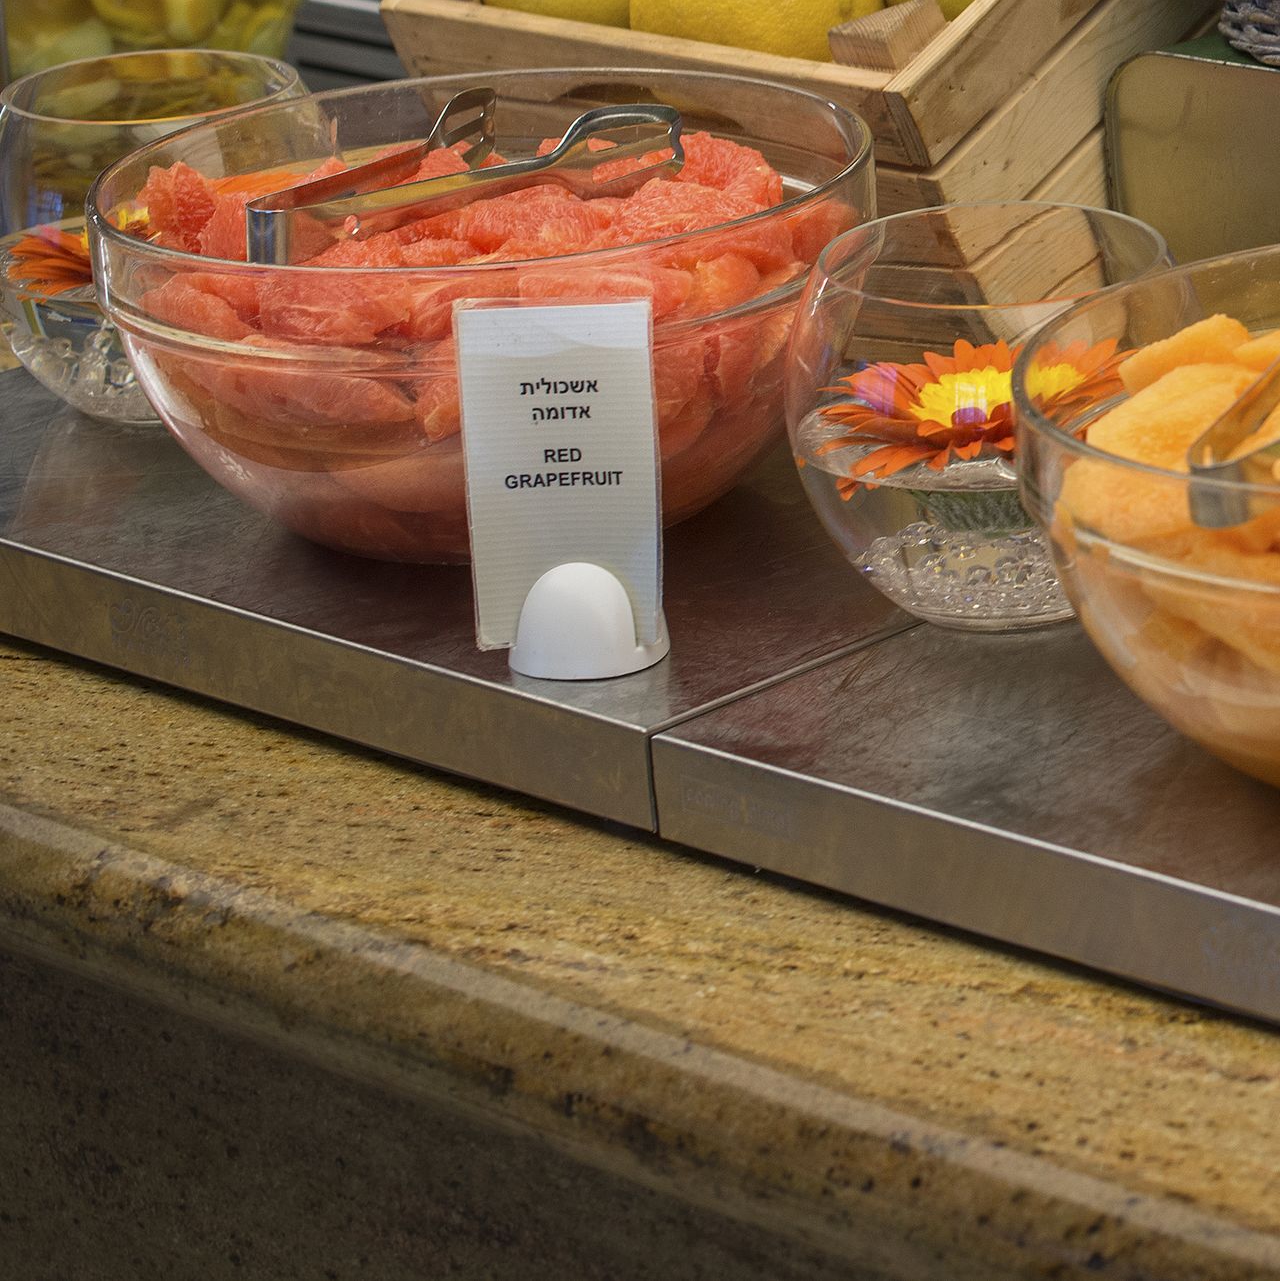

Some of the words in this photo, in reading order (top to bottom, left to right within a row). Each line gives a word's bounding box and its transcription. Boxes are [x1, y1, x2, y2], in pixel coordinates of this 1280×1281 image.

[519, 377, 599, 396] אשכולית
[532, 405, 591, 421] אדומה
[543, 447, 582, 464] RED
[504, 470, 623, 490] GRAPEFRUIT
